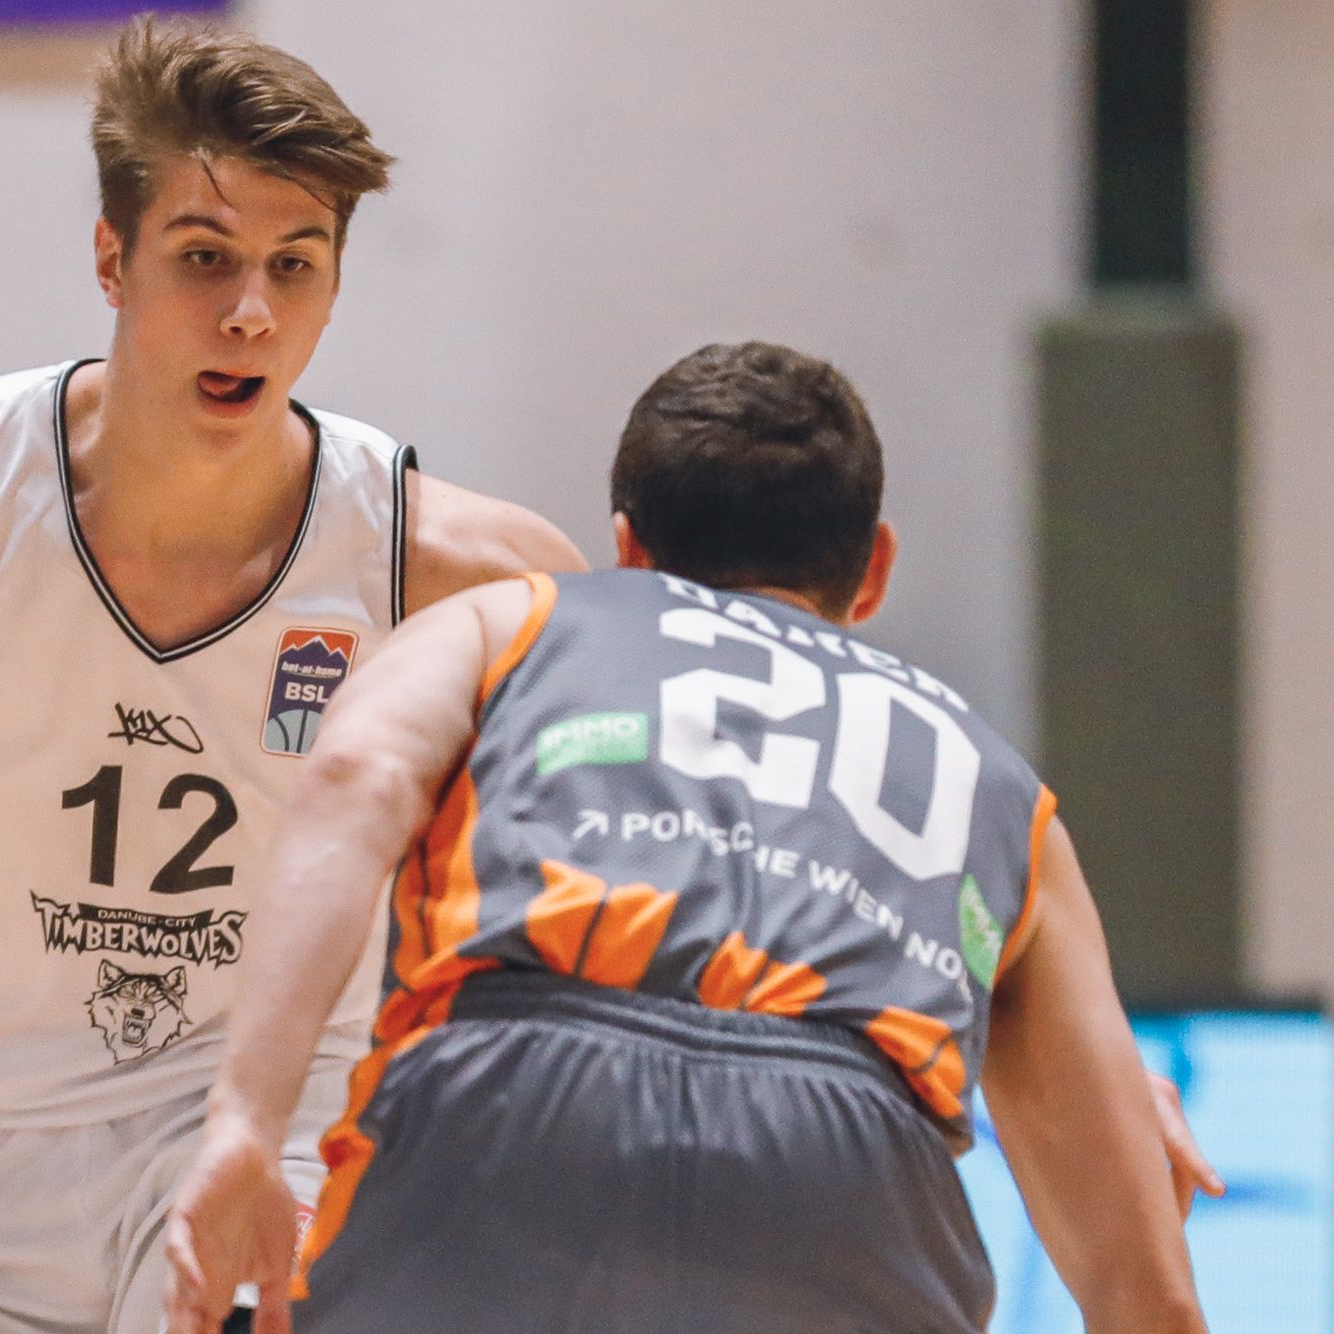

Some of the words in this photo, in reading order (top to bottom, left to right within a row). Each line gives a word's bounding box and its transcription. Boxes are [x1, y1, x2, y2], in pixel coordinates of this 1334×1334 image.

[280, 660, 343, 678] bet-at-home
[284, 681, 329, 703] BSL
[660, 607, 981, 880] 20
[61, 764, 239, 895] 12
[29, 889, 251, 970] TIMBERWOLVES
[808, 858, 904, 941] WIEN
[904, 929, 972, 1005] NO
